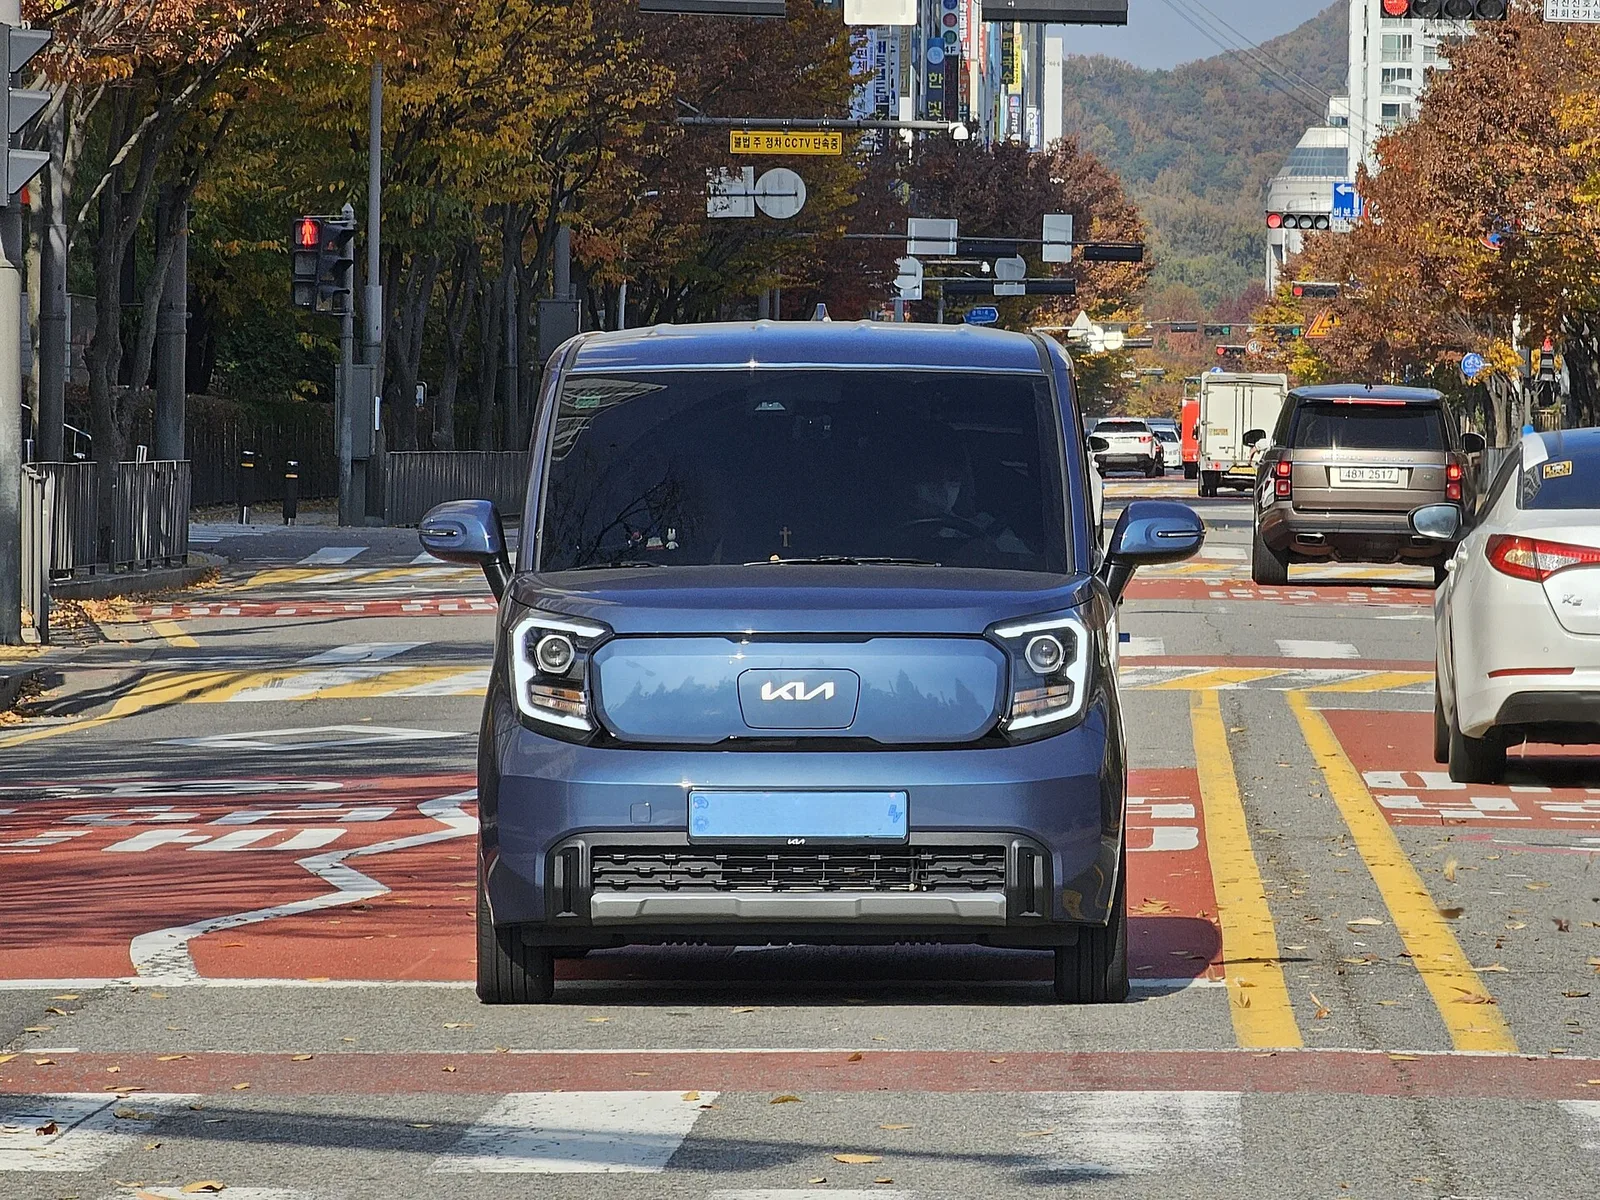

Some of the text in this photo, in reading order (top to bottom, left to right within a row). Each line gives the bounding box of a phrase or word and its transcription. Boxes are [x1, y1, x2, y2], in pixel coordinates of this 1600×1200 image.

[734, 136, 751, 149] 불법
[784, 138, 811, 148] CCTV
[814, 137, 839, 150] 단속중
[1333, 206, 1361, 217] 비보호
[1368, 469, 1394, 480] 2517
[760, 680, 835, 701] KIA
